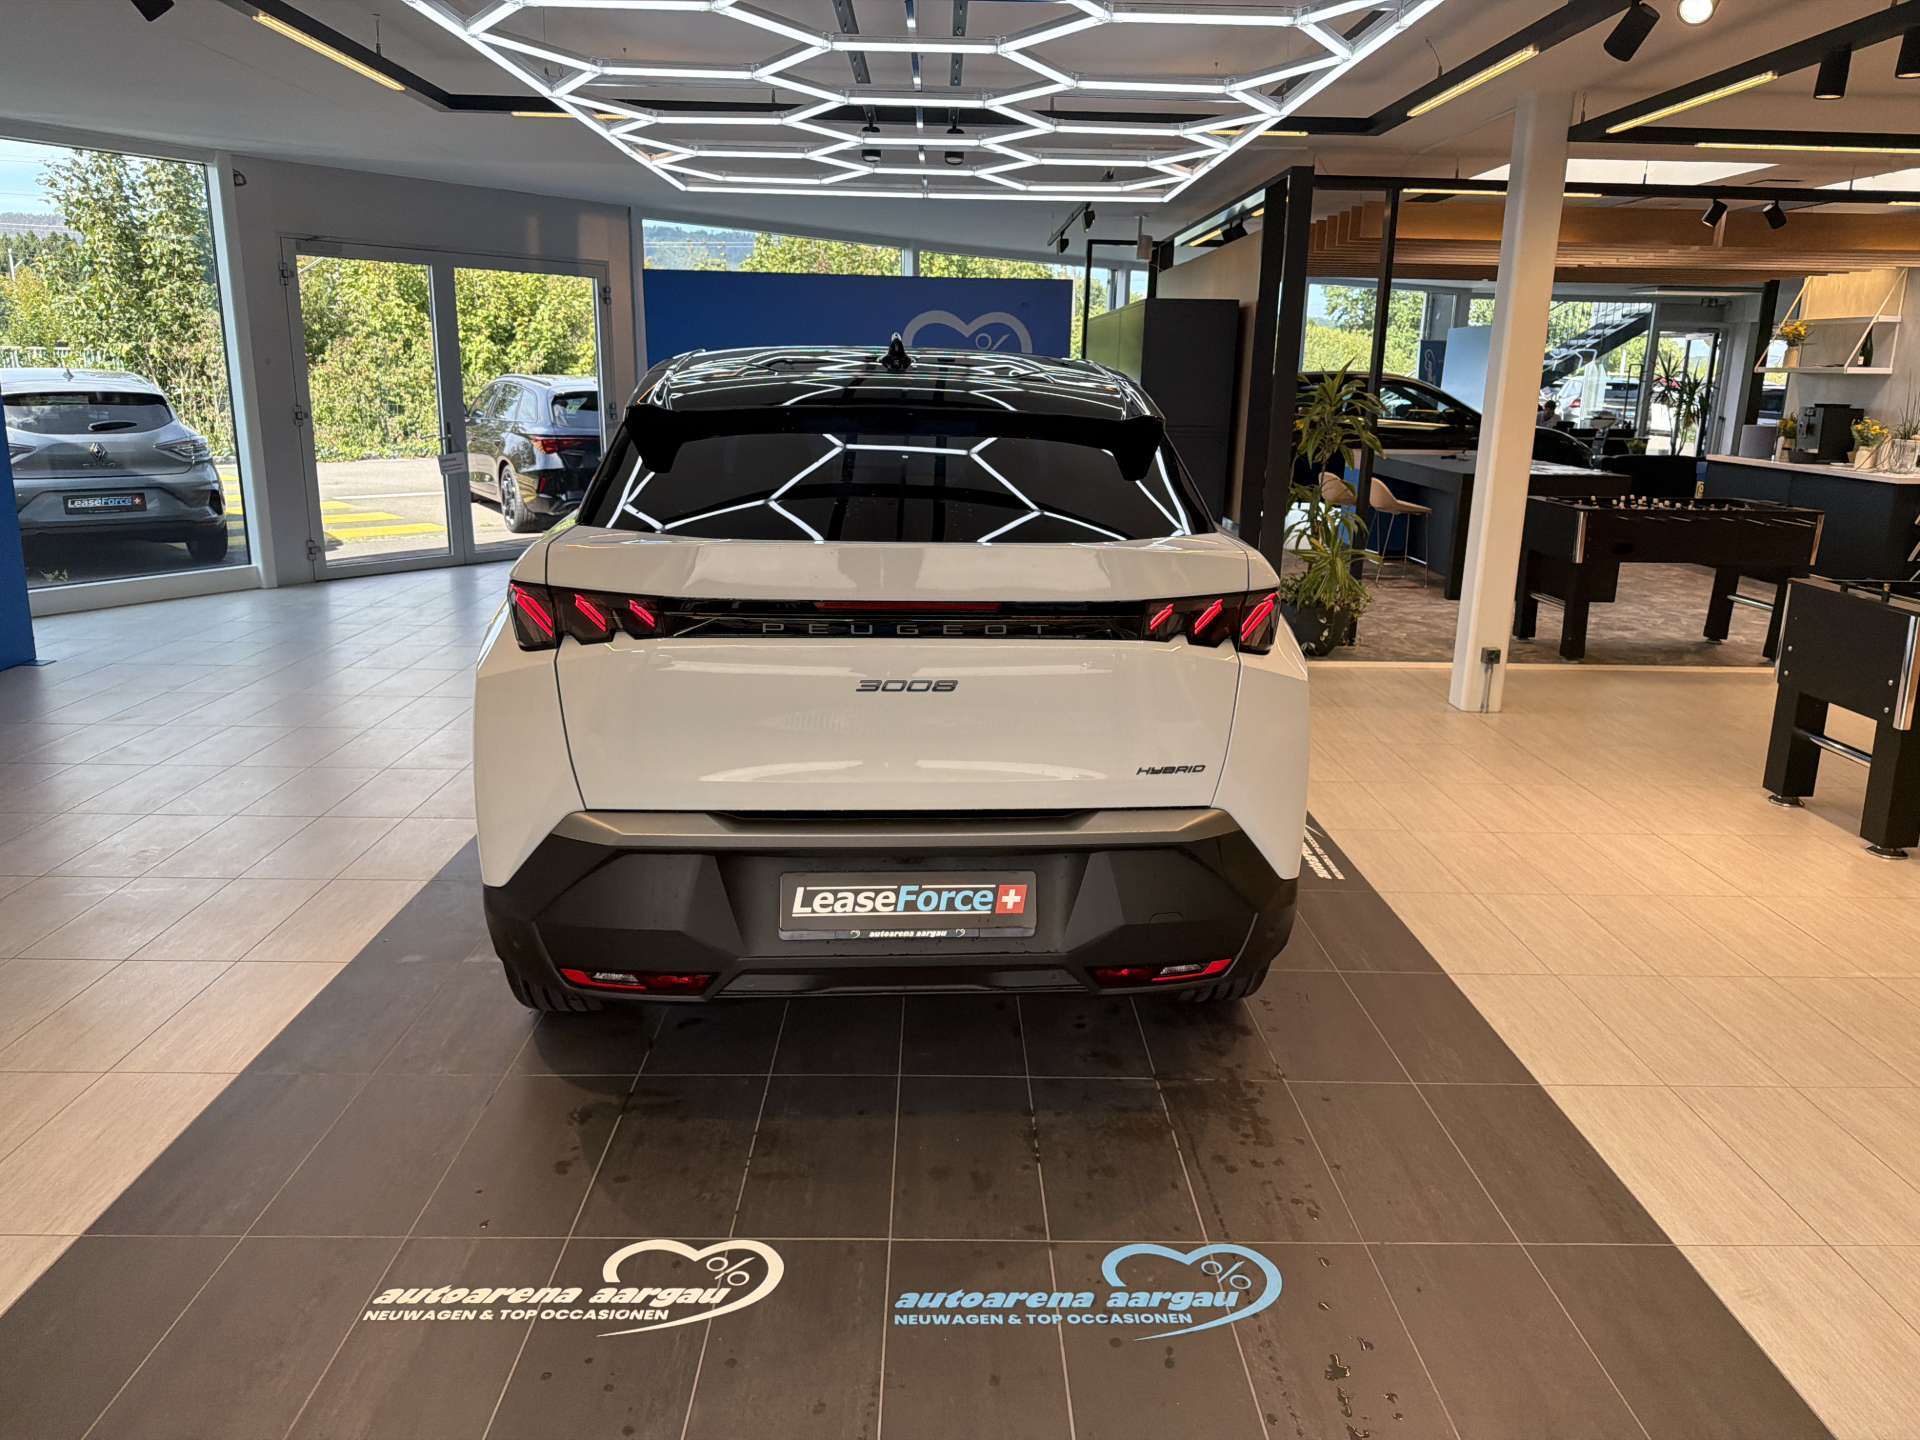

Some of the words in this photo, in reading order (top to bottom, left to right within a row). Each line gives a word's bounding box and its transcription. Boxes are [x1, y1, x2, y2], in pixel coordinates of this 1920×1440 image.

[67, 496, 132, 508] LeaseForce
[762, 623, 1050, 635] PEUGEOT
[856, 679, 959, 692] 3008
[1136, 764, 1206, 776] HYBRID
[792, 884, 993, 913] LeaseForce
[868, 929, 914, 938] autoarena
[915, 929, 947, 938] aargau
[372, 1284, 584, 1305] autoarena
[588, 1287, 732, 1307] aargau
[894, 1288, 1096, 1309] autoarena
[1106, 1291, 1239, 1311] aargau
[362, 1309, 477, 1321] NEUWAGEN
[479, 1309, 494, 1321] &
[500, 1309, 539, 1321] TOP
[540, 1309, 670, 1321] OCCASIONEN
[894, 1313, 1004, 1325] NEUWAGEN
[1008, 1313, 1022, 1325] &
[1026, 1313, 1063, 1325] TOP
[1067, 1313, 1193, 1325] OCCASIONEN
